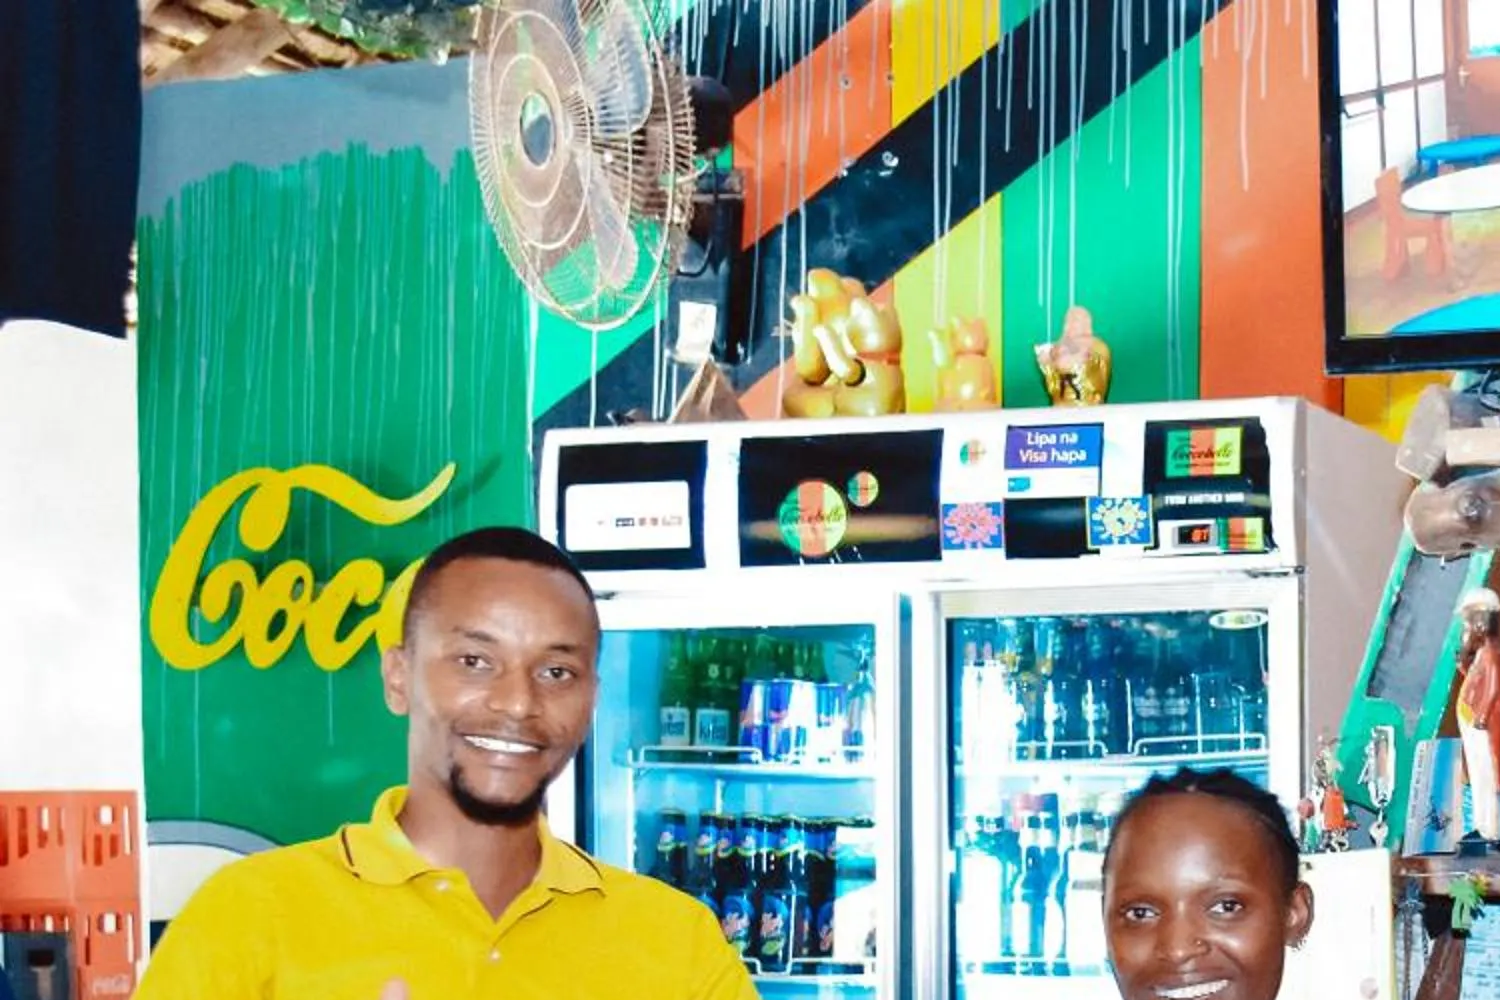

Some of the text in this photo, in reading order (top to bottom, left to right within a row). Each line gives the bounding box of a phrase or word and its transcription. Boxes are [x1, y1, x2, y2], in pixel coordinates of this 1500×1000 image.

[1027, 432, 1079, 448] Lipa na
[1020, 448, 1088, 465] Visa hapa
